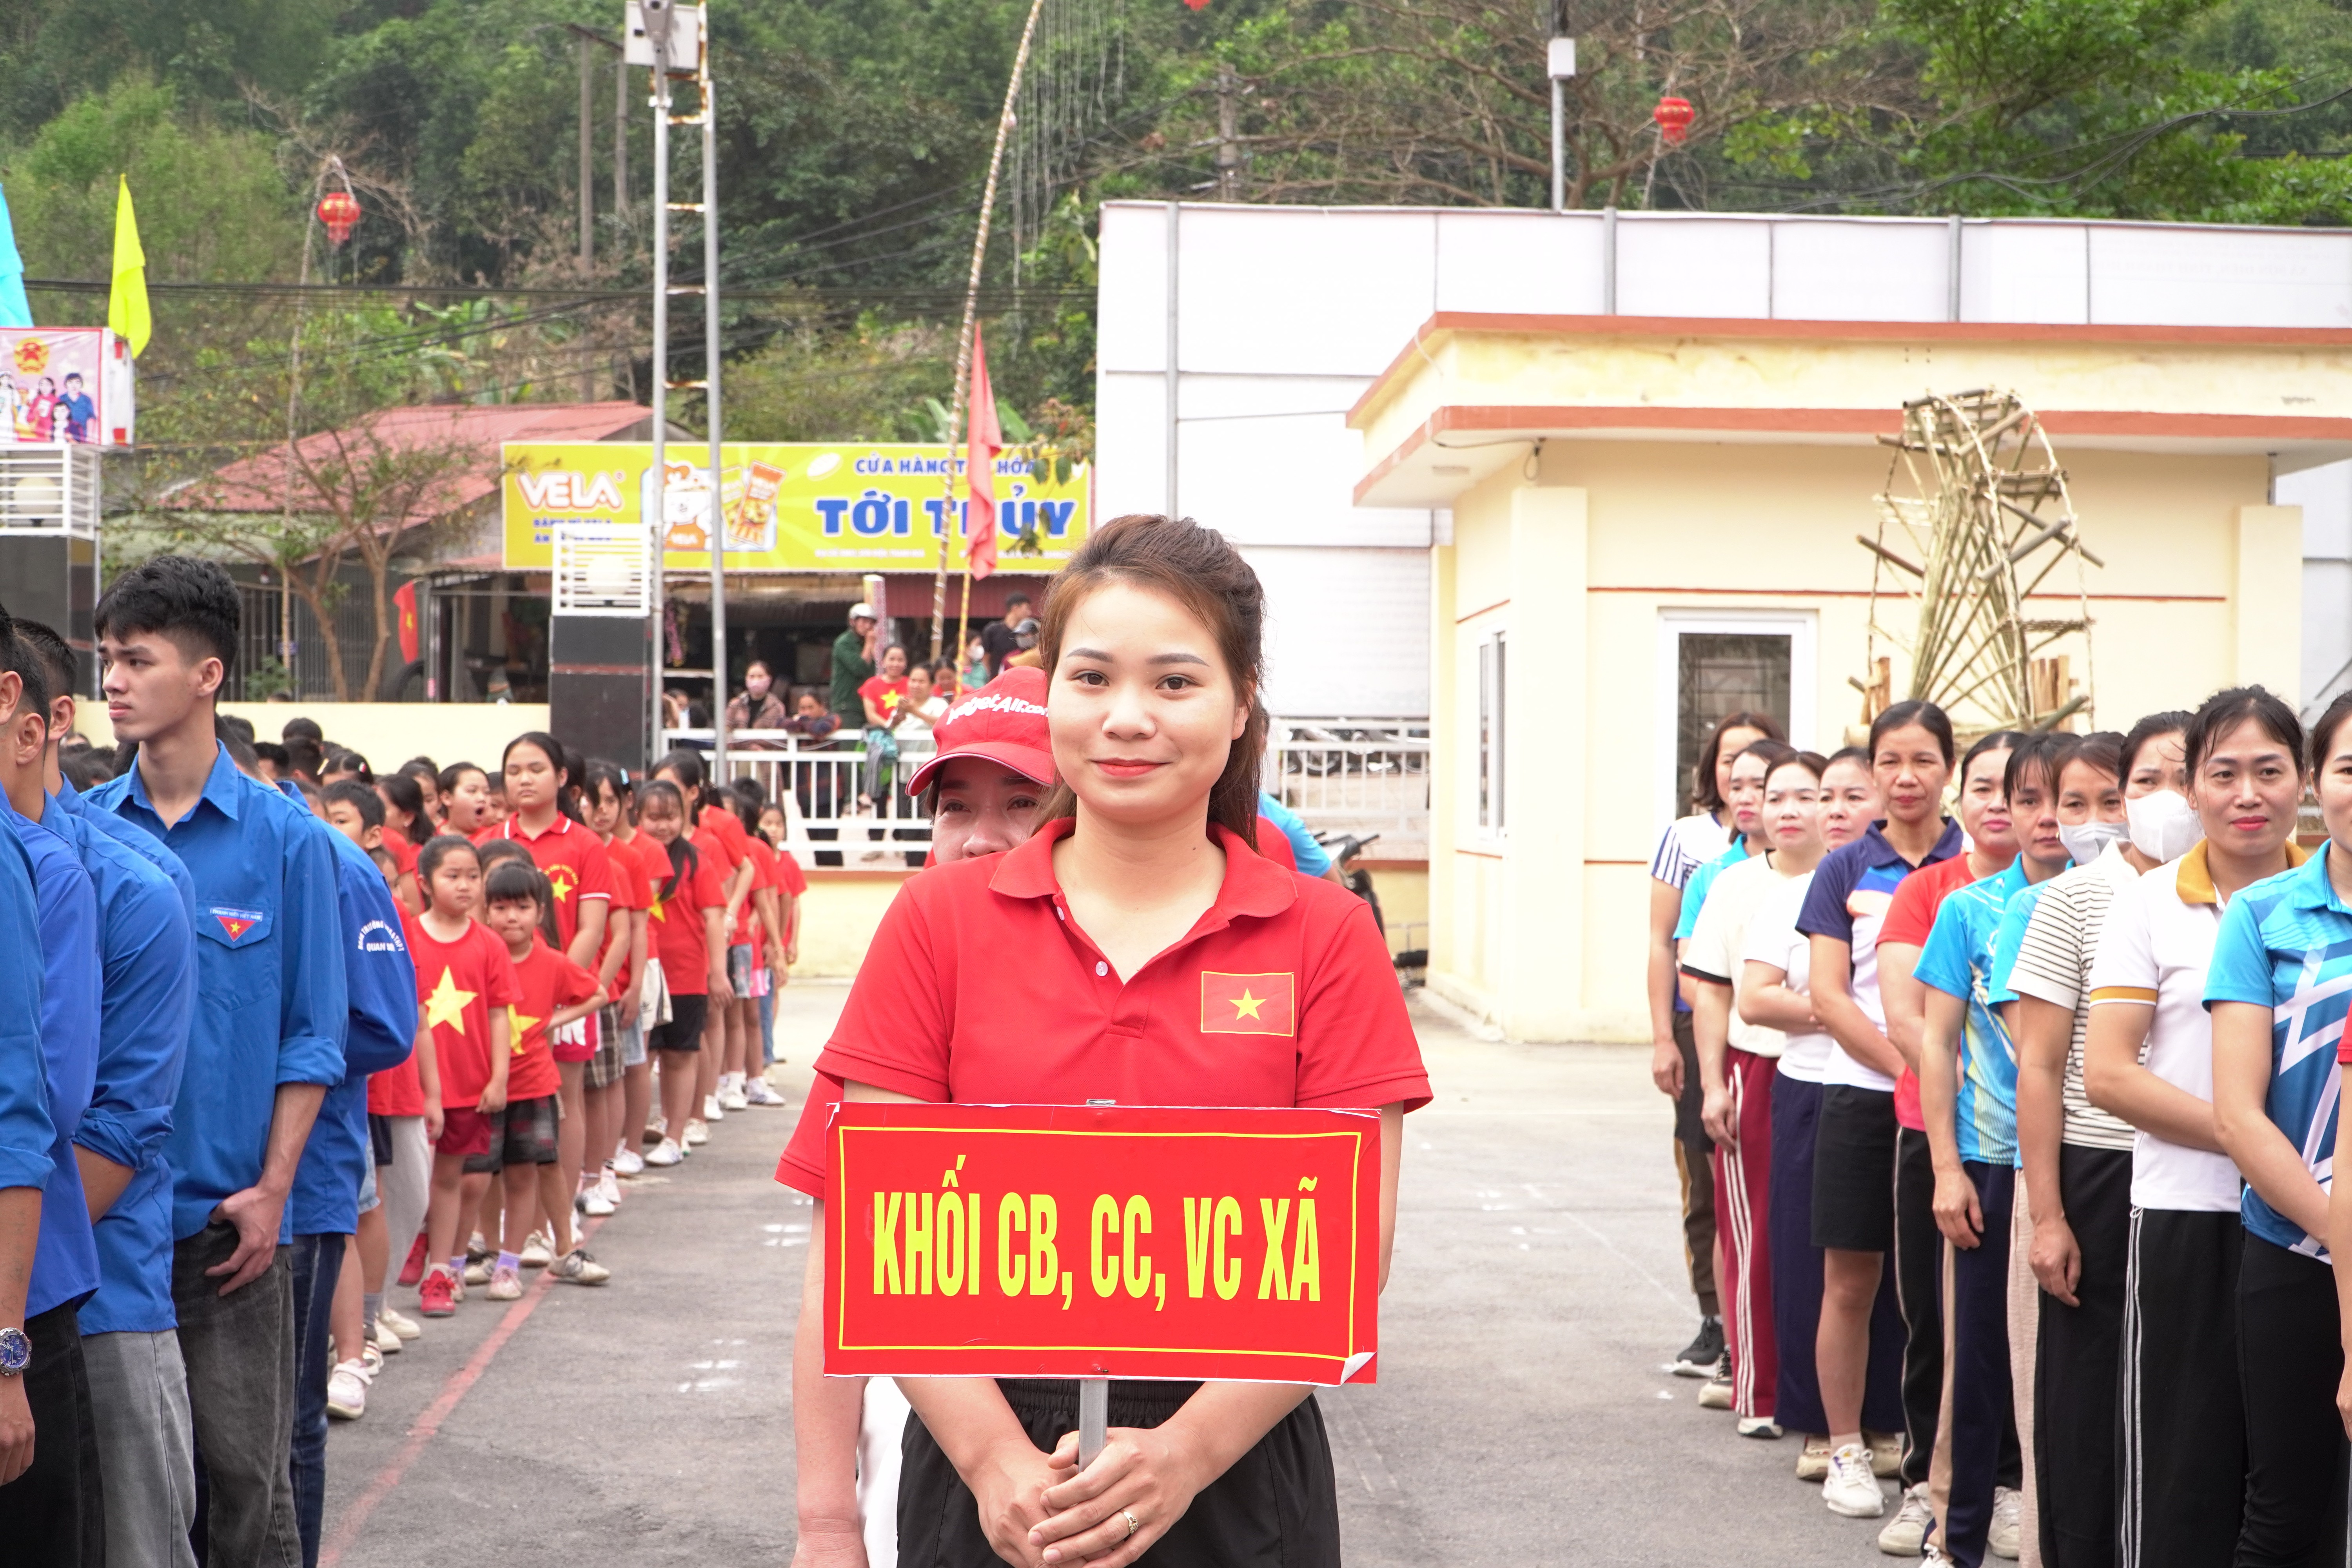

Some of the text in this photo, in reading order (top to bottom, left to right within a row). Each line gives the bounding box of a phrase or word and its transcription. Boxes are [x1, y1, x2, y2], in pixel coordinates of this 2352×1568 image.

[517, 472, 622, 509] VELA
[817, 485, 1074, 535] TỚI TỦY
[874, 1155, 1320, 1311] KHỐI CB, CC, VC XÃ
